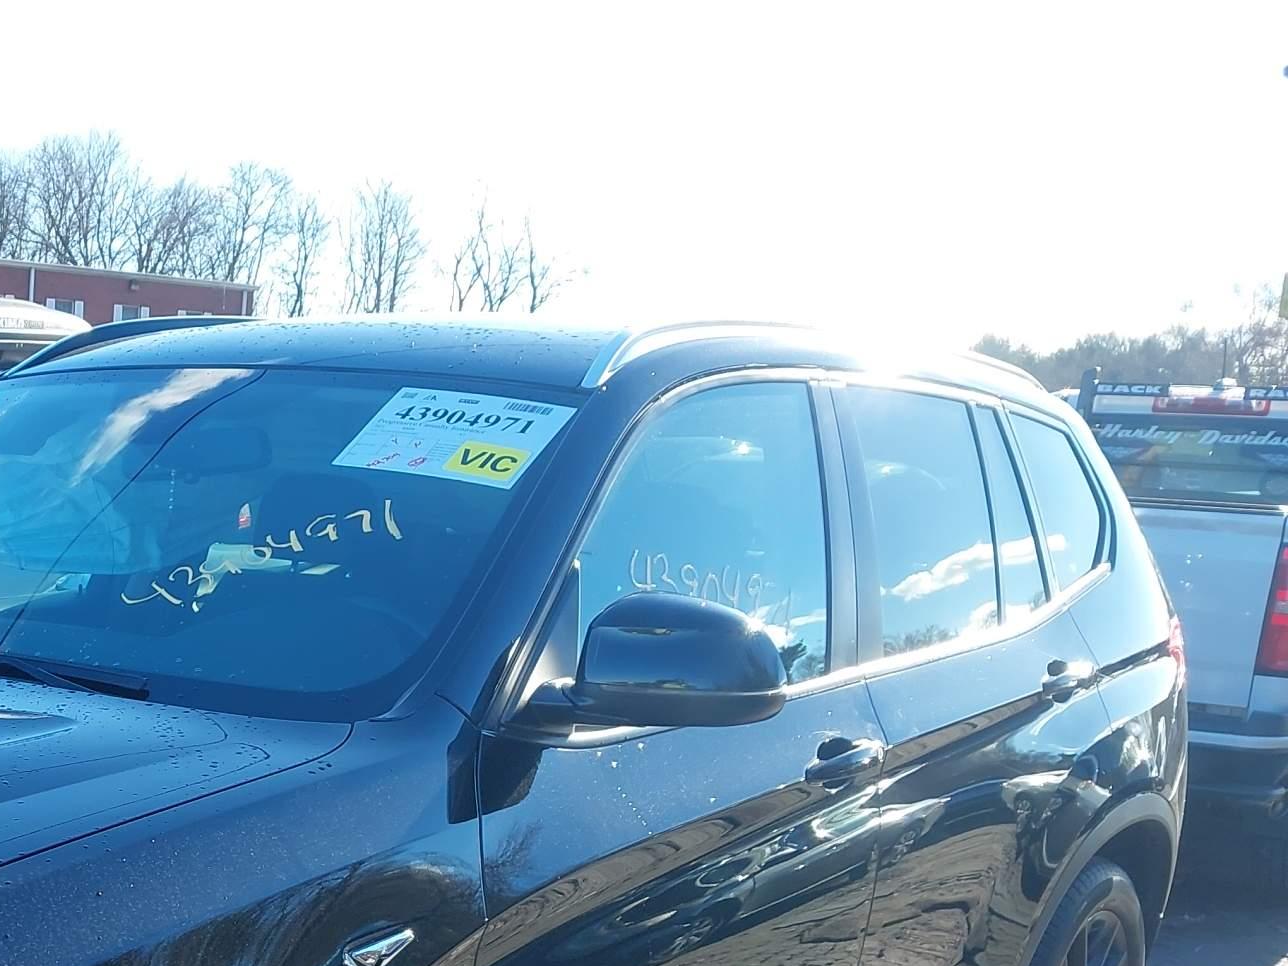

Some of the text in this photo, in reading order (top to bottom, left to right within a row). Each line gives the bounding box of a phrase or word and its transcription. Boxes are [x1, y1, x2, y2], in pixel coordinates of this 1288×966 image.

[1096, 383, 1288, 398] BACK RA
[394, 405, 535, 434] 43904971
[460, 447, 518, 473] VIC
